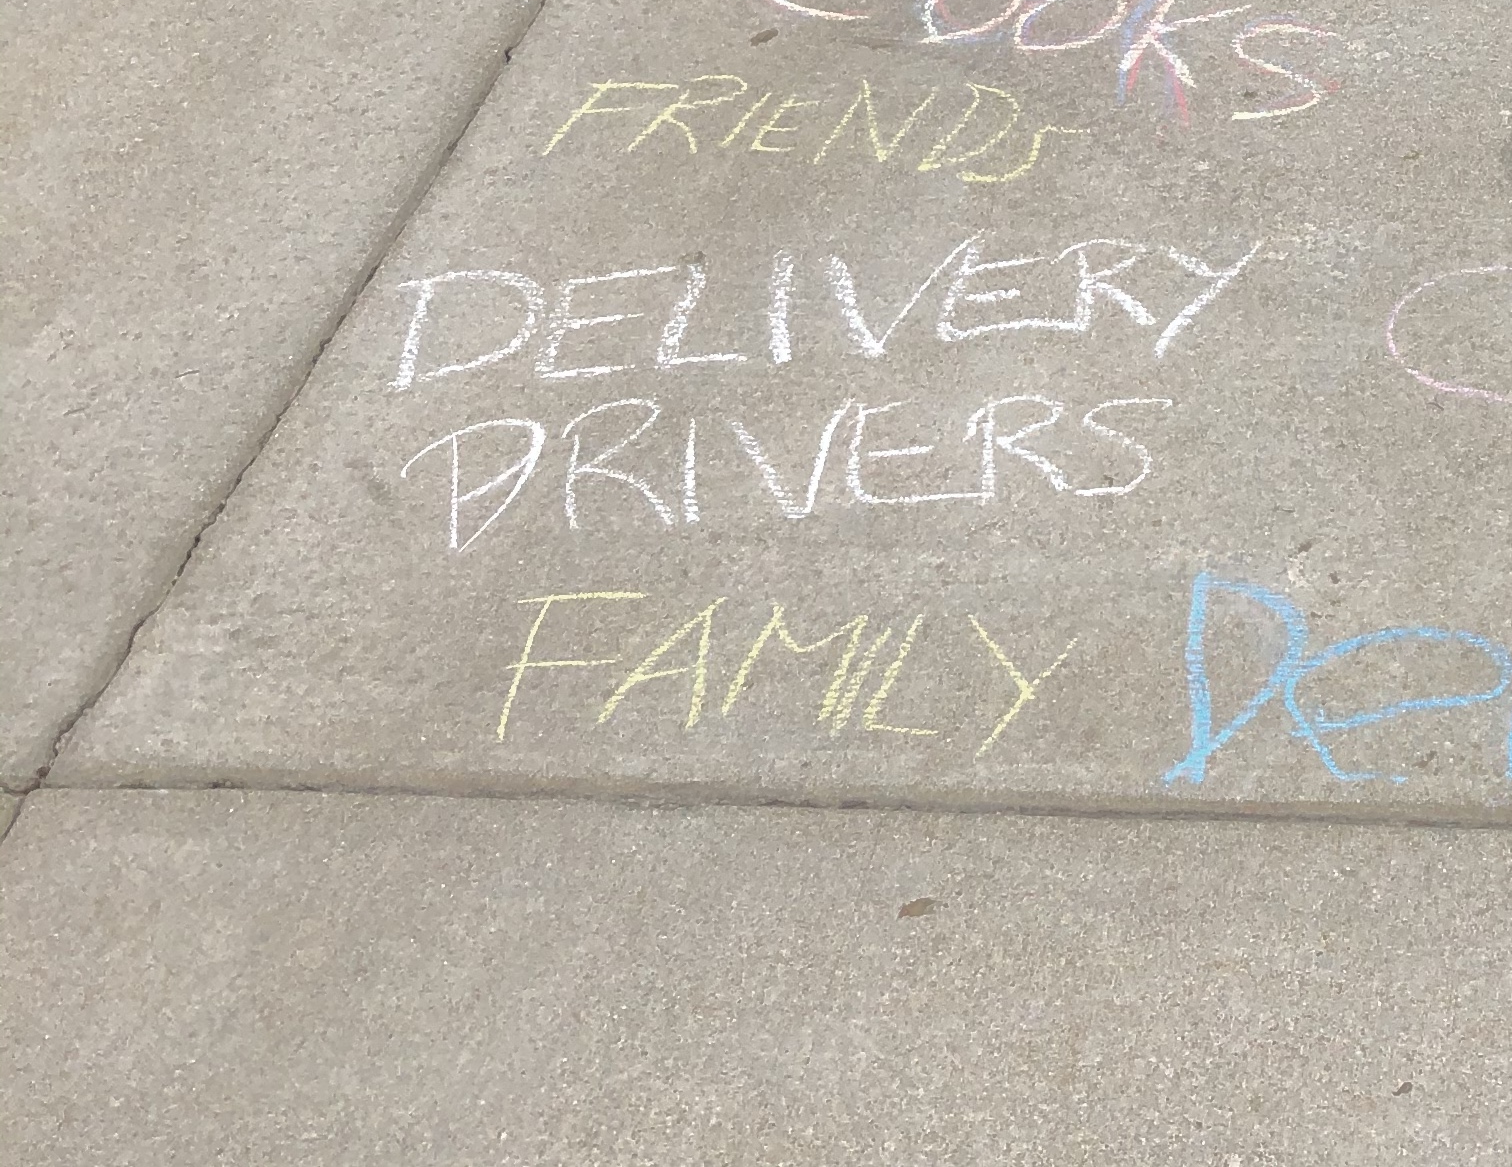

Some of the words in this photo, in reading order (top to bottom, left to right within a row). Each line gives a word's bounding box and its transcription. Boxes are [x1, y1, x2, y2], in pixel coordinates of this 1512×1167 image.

[541, 74, 1092, 182] FRIENDS
[388, 230, 1265, 390] DELIVERY
[399, 394, 1173, 551] DRIVERS
[497, 589, 1079, 757] FAMILY
